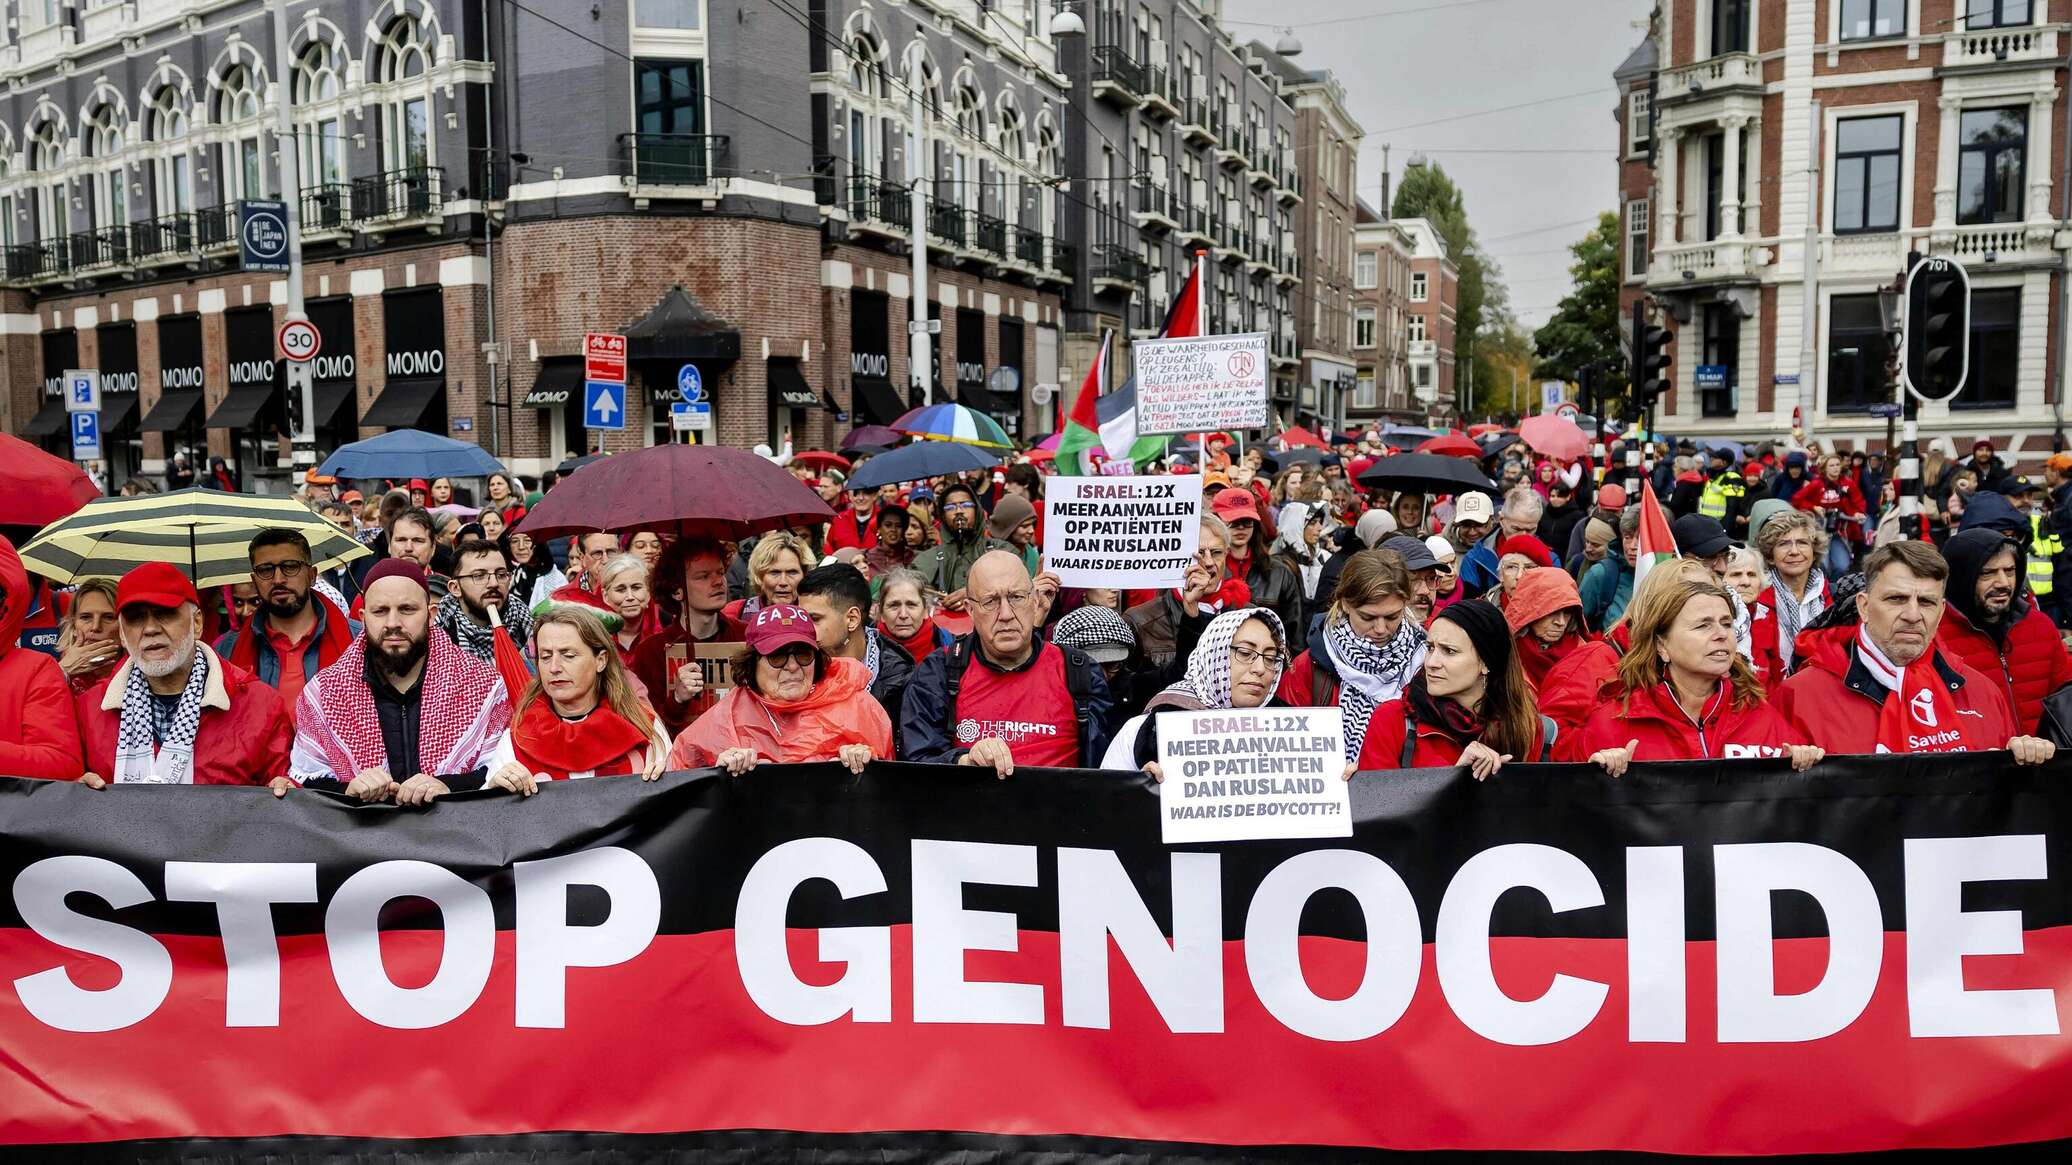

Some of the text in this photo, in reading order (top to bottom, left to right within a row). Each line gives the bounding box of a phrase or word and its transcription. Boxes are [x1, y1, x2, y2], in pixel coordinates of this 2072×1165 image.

[262, 231, 282, 240] JAPAN
[1929, 260, 1948, 271] 701
[288, 333, 312, 348] 30
[1140, 346, 1150, 356] IS
[1152, 346, 1165, 355] DE
[1167, 343, 1218, 353] WAARHEID
[387, 350, 444, 375] MOMO
[851, 353, 888, 377] MOMO
[1140, 356, 1154, 366] OP
[162, 366, 203, 388] MOMO
[230, 360, 275, 383] MOMO
[956, 362, 984, 382] MOMO
[1160, 365, 1180, 374] ZEG
[1176, 371, 1214, 383] KAPPER
[78, 382, 88, 393] P
[101, 372, 138, 392] MOMO
[526, 391, 569, 403] MOMO
[654, 389, 710, 400] MOO
[782, 392, 818, 403] MOMO
[78, 414, 92, 433] P
[1077, 484, 1176, 499] ISRAEL: 12X
[1053, 502, 1194, 516] MEER AANVALLEN
[1064, 517, 1182, 535] OP PATIËNTEN
[1064, 538, 1182, 552] DAN RUSLAND
[1051, 558, 1192, 570] WAAR IS DE BOYCOTT?!
[1192, 716, 1310, 734] ISRAEL: 12X
[982, 730, 1025, 742] FORUM
[1938, 730, 1960, 745] the
[1167, 736, 1336, 756] MEER AANVALLEN
[1183, 753, 1324, 777] OP PATIËNTEN
[1184, 778, 1324, 798] DAN RUSLAND
[1170, 802, 1341, 820] WAAR IS DE BOYCOTT?!
[12, 834, 2061, 1046] STOP GENOCIDE
